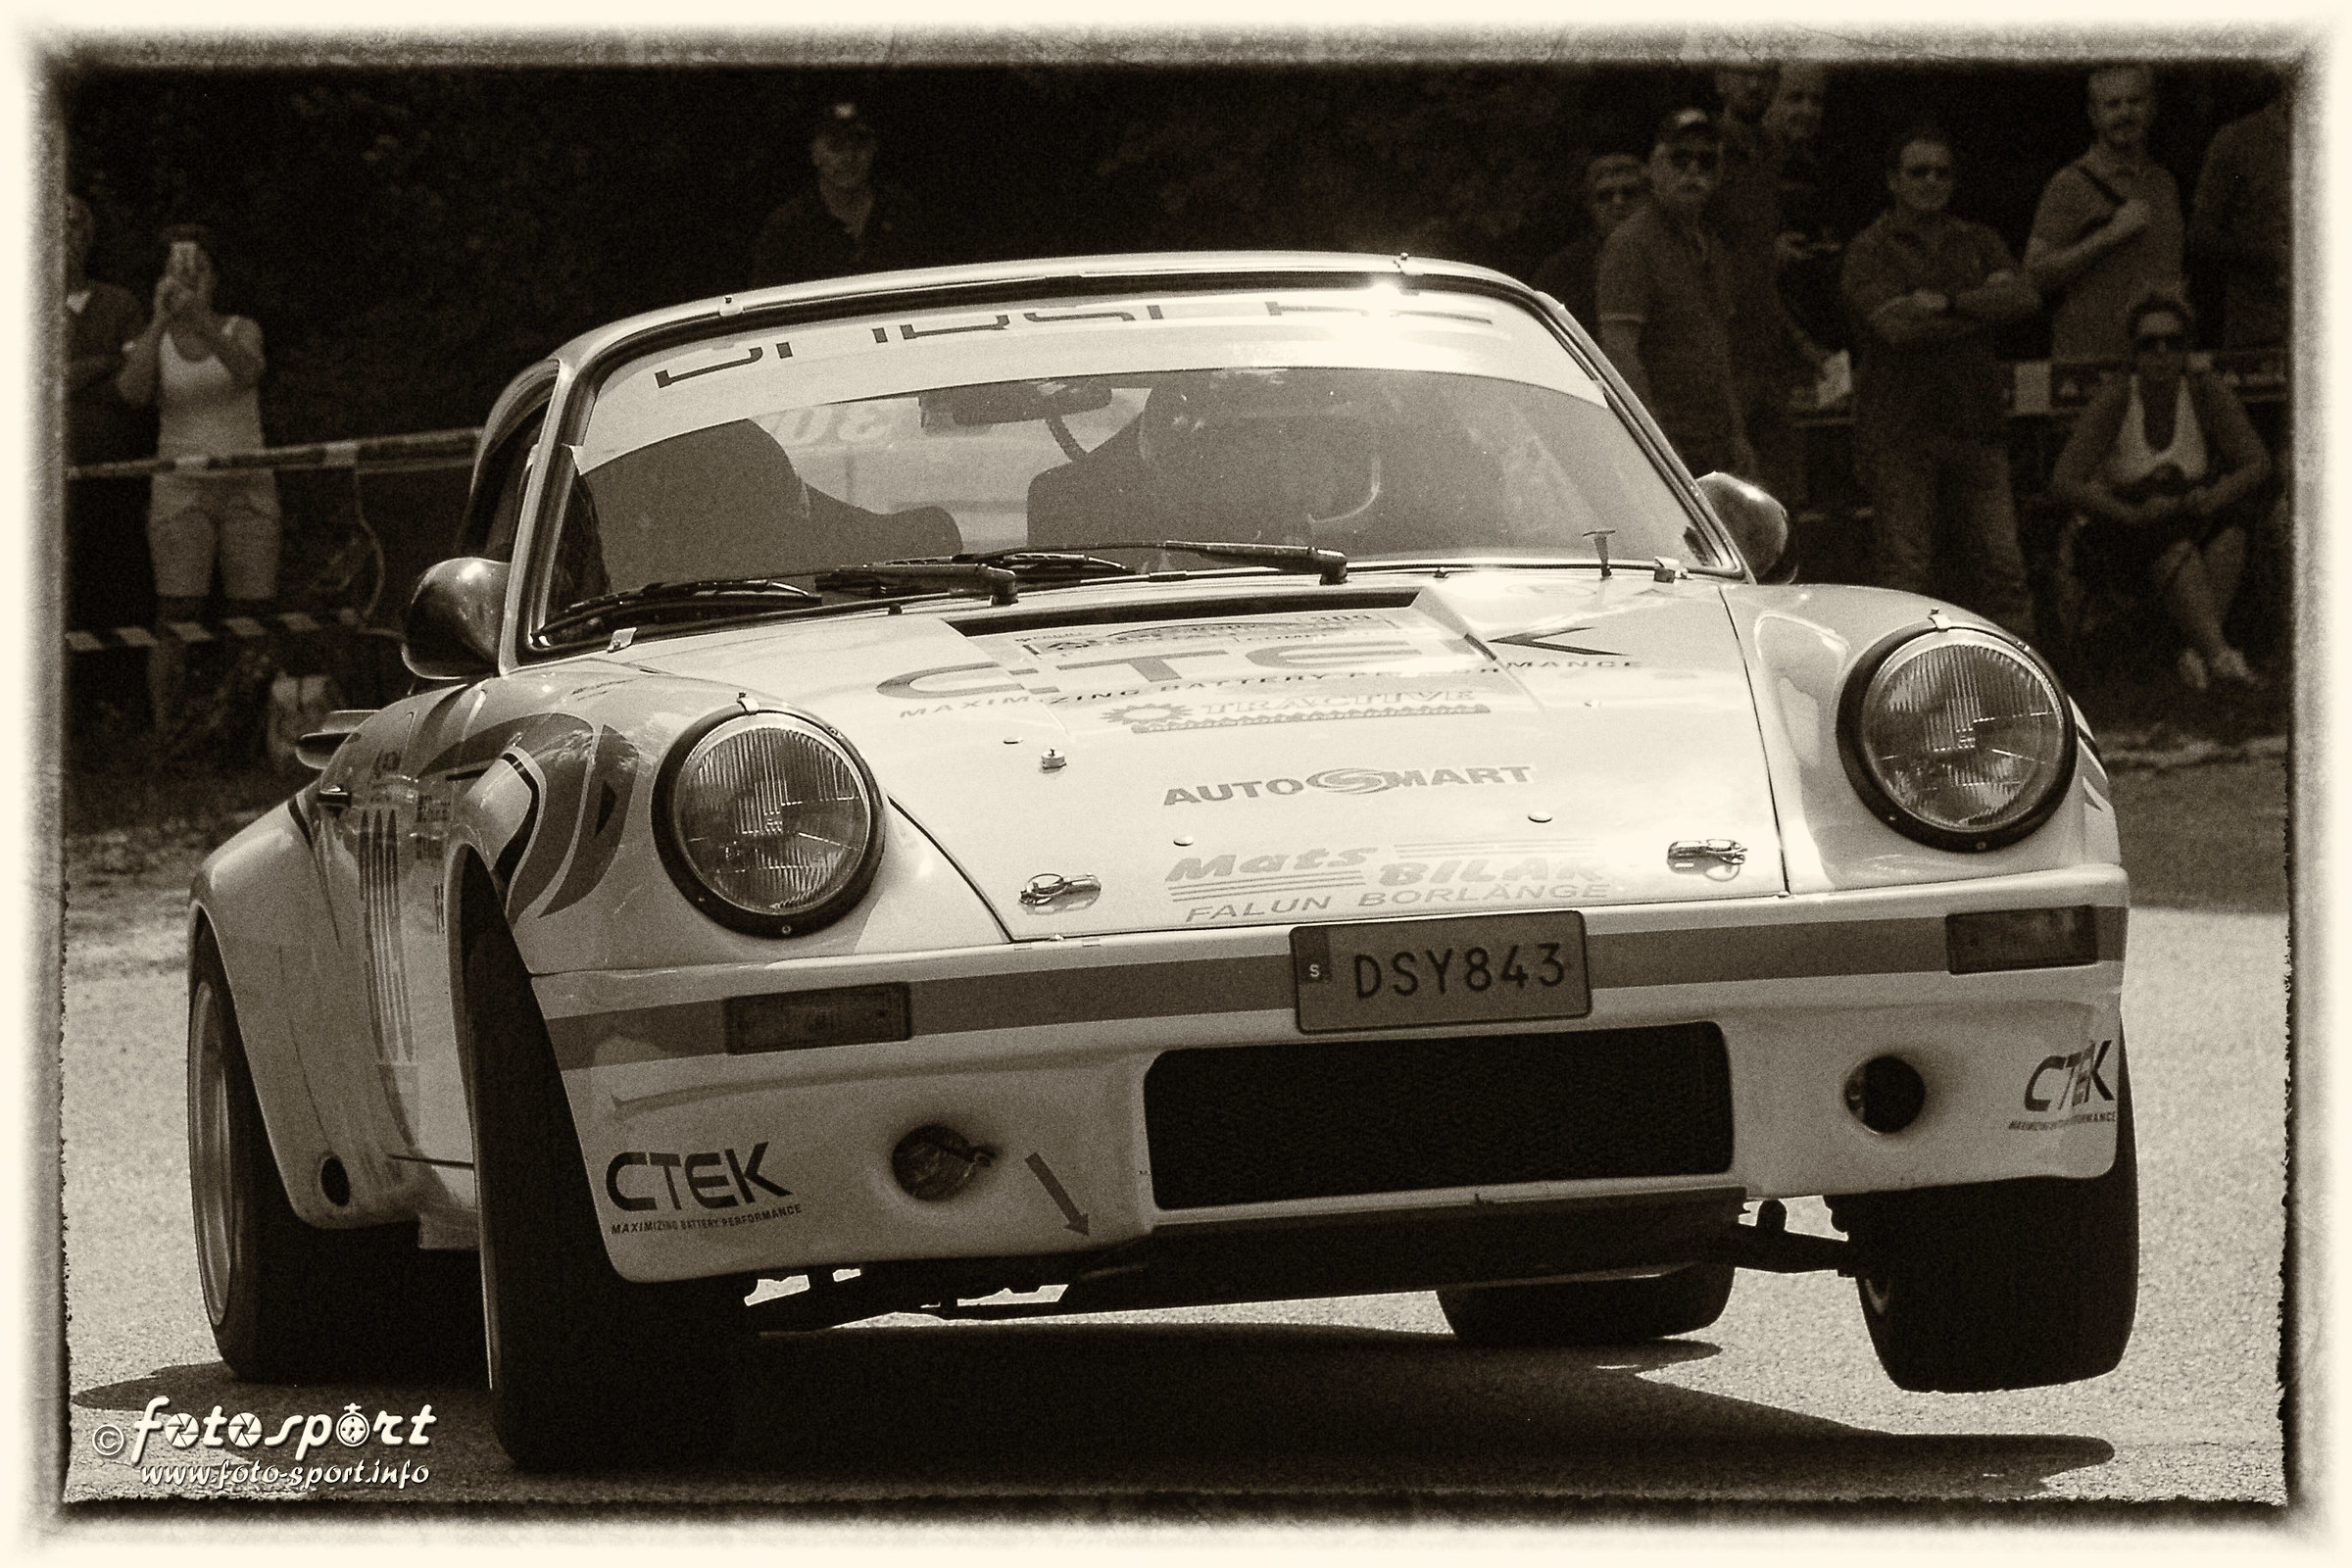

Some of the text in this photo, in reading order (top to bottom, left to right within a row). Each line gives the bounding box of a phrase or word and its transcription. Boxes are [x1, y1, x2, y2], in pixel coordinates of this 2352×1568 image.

[1165, 847, 1378, 882] Mats
[1186, 882, 1610, 922] FALUN BORLÄNGE
[1309, 942, 1566, 1000] S DSY843
[2024, 1039, 2115, 1112] CTEK
[606, 1141, 793, 1212] CTEK
[611, 1203, 802, 1235] MAXIMIZING BATTERY PERFORMANCE
